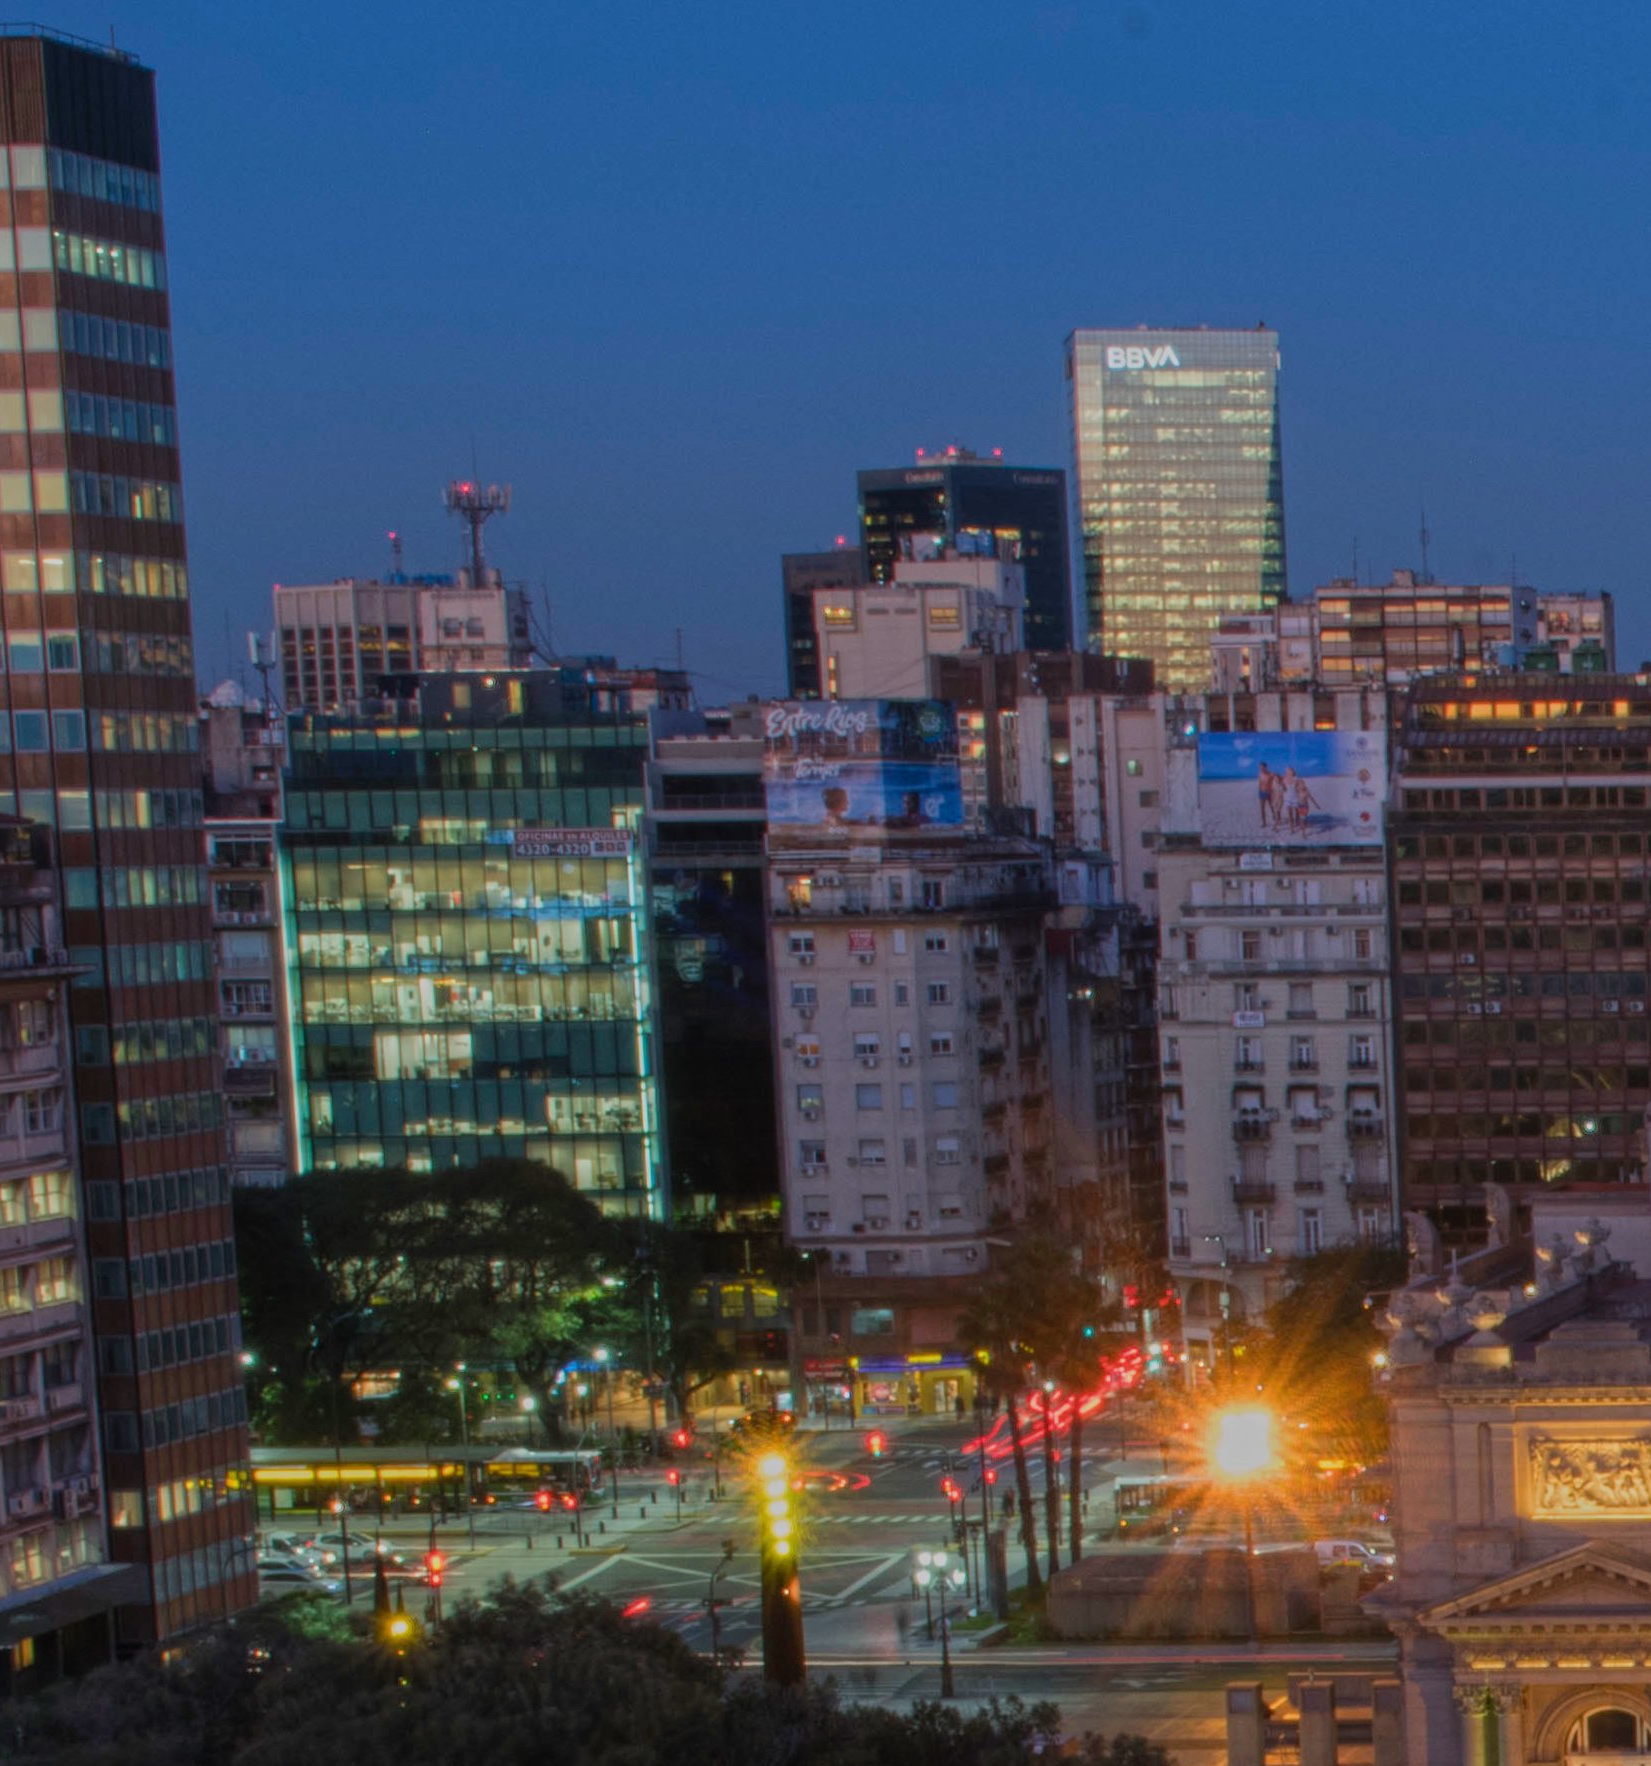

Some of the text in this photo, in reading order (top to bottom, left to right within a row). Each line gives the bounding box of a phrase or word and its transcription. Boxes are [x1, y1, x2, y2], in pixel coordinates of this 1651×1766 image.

[1107, 345, 1180, 369] BBVA
[766, 708, 821, 738] Entre
[517, 832, 564, 841] OFICINAS
[516, 843, 589, 857] 4320-4320
